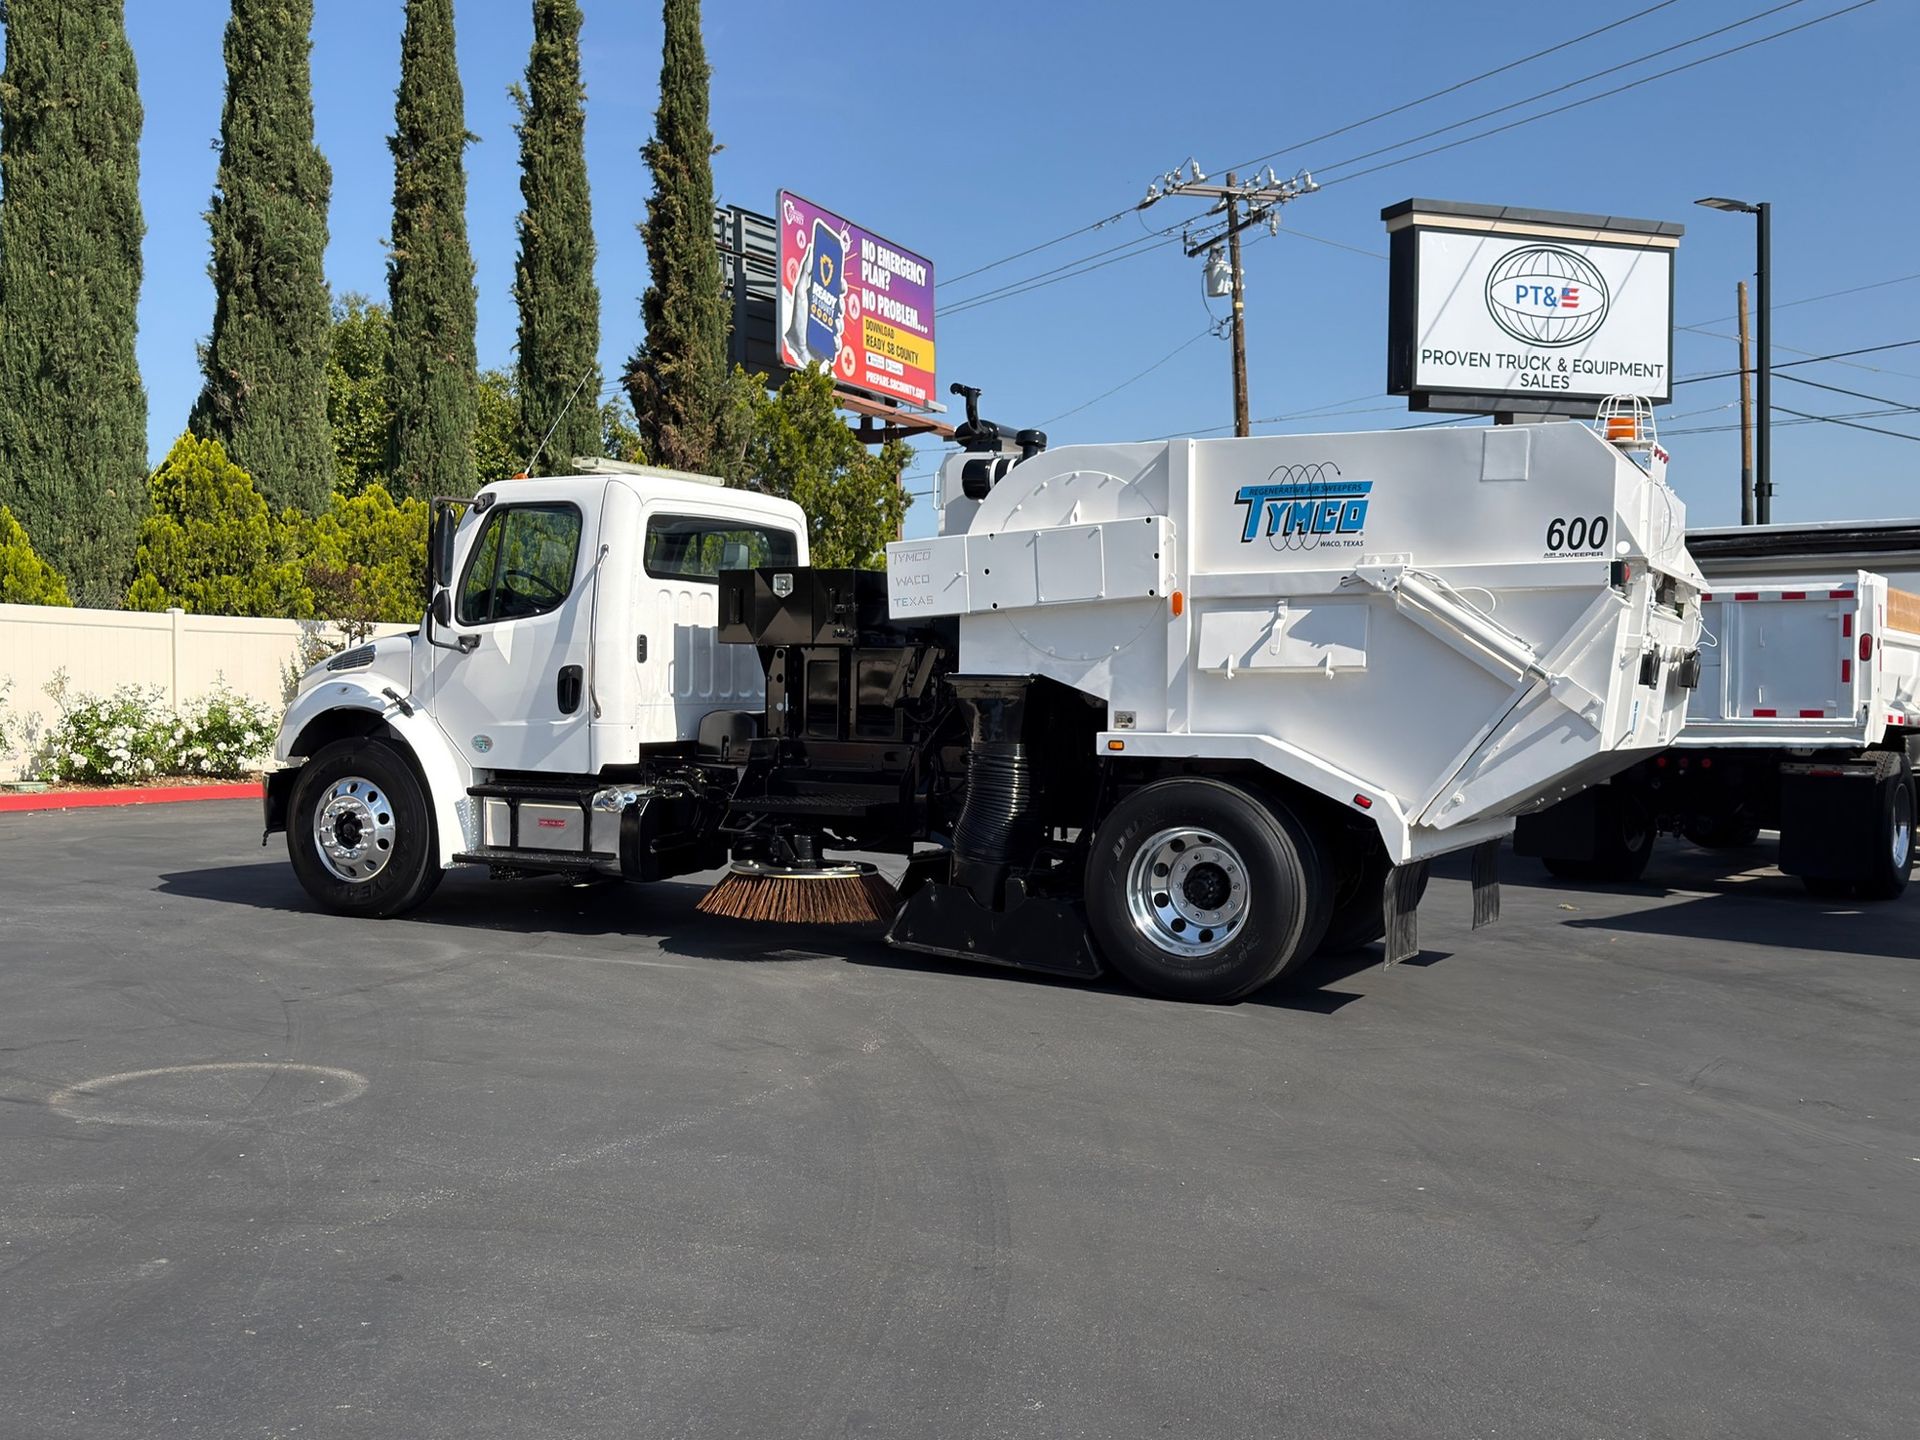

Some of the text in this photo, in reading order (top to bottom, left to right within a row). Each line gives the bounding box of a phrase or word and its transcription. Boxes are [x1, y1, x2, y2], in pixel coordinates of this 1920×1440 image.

[861, 238, 927, 286] NO EMERGENCY
[861, 262, 891, 291] PLAN?
[812, 281, 838, 309] READY
[861, 288, 875, 312] NO
[1515, 284, 1580, 308] PT&E
[866, 319, 895, 339] DOWNLOAD
[866, 334, 886, 352] READY
[887, 341, 895, 355] SB
[896, 345, 919, 365] COUNTY
[1421, 349, 1664, 379] PROVEN TRUCK & EQUIPMENT
[1520, 373, 1570, 390] SALES
[1249, 484, 1362, 496] REGENERATIVE AIR SWEEPERS
[1234, 481, 1374, 543] TYMCO
[1546, 516, 1609, 551] 600
[889, 548, 932, 565] TYMCO
[895, 574, 930, 587] WACO
[893, 595, 934, 608] TEXAS
